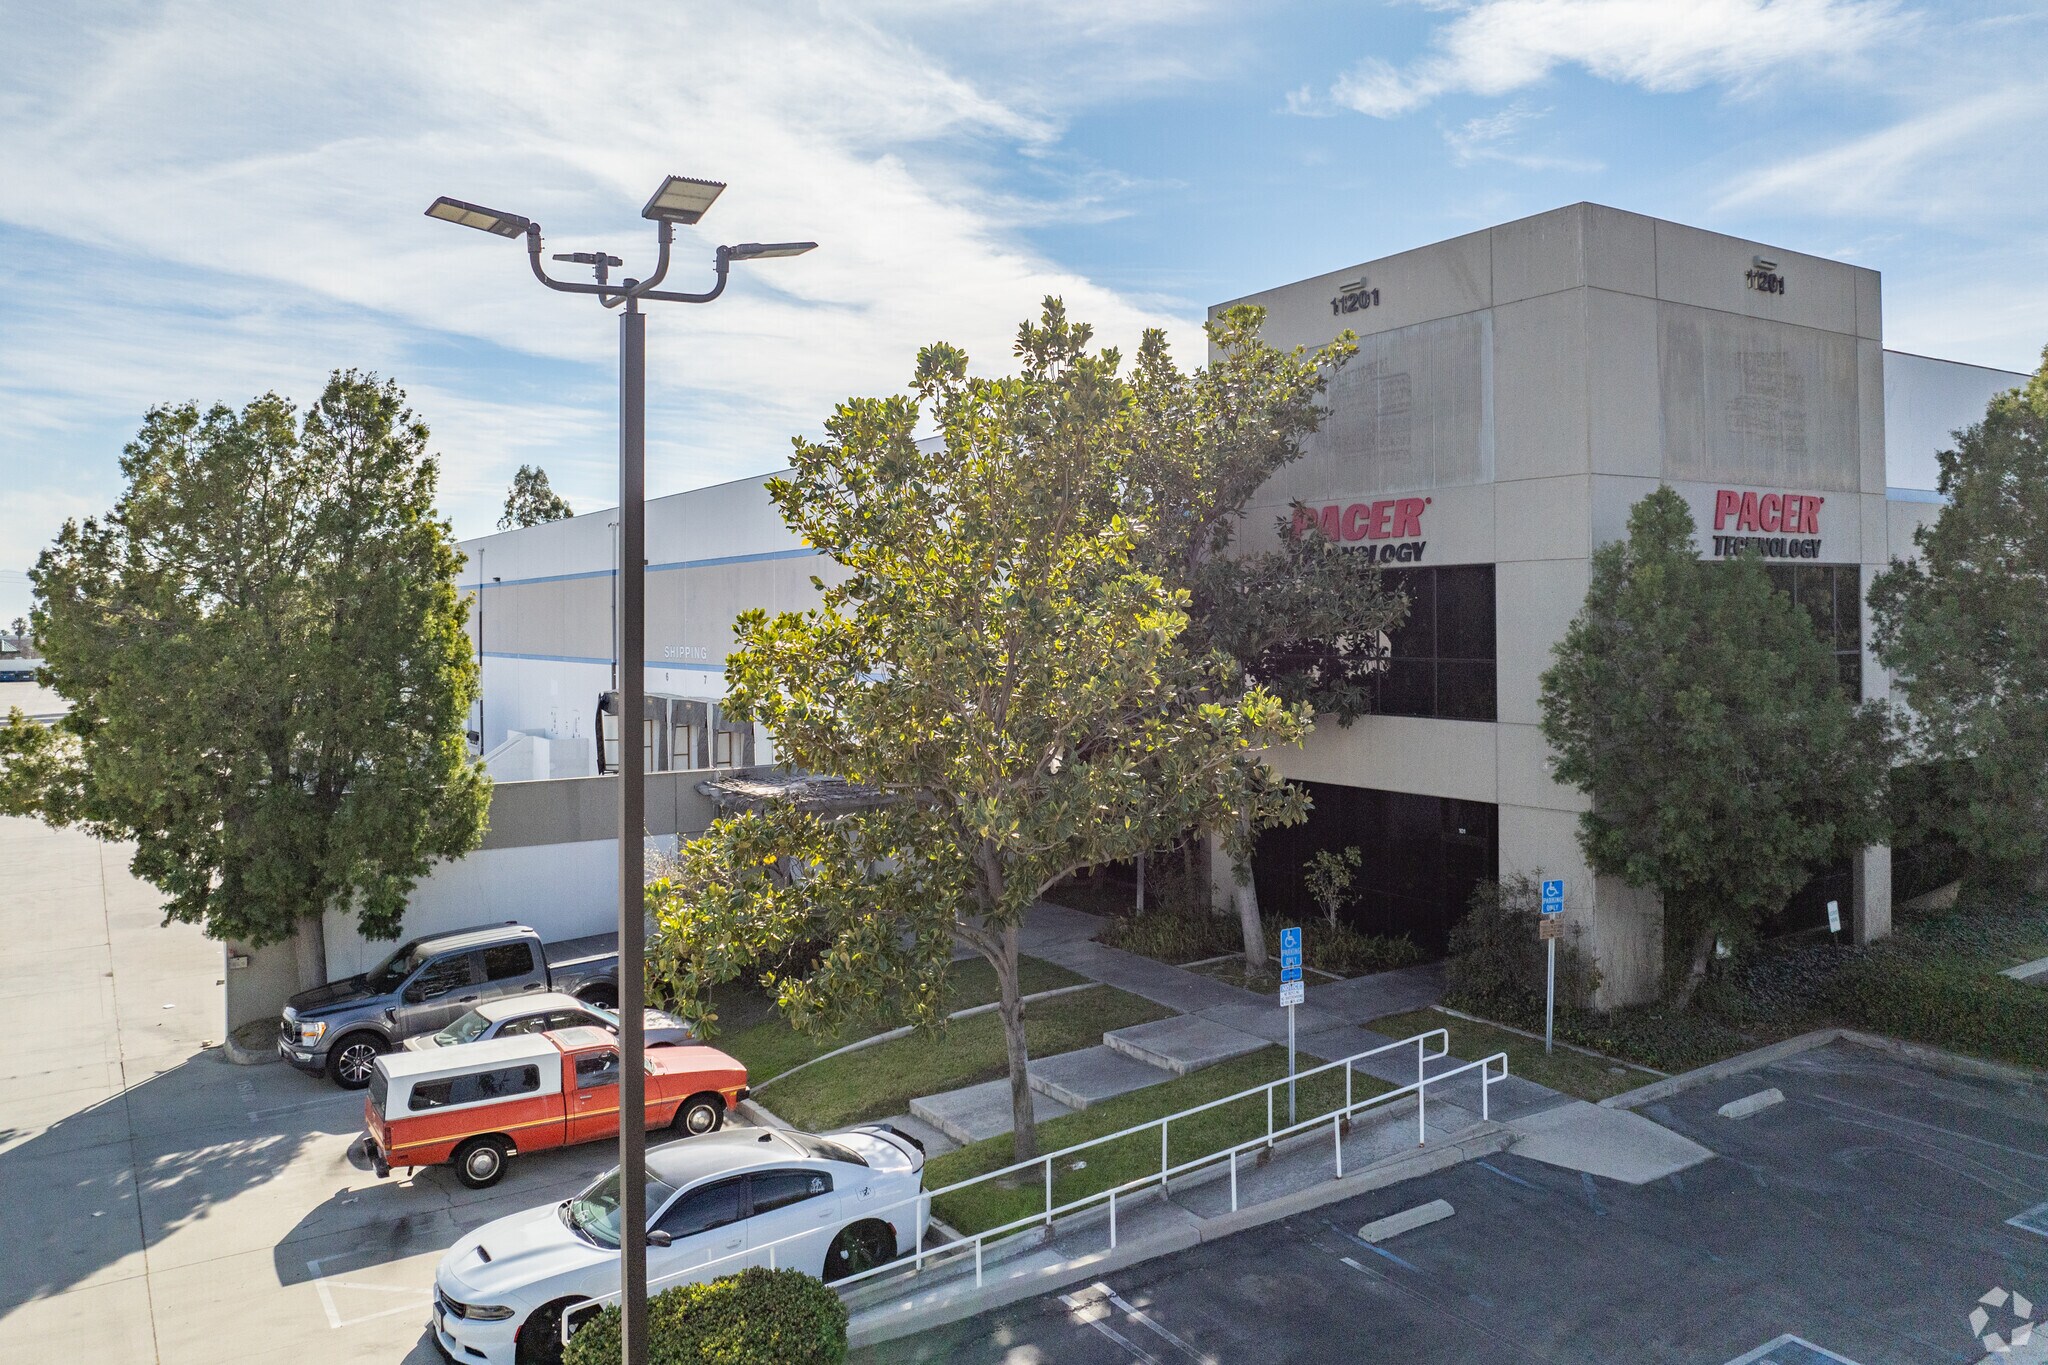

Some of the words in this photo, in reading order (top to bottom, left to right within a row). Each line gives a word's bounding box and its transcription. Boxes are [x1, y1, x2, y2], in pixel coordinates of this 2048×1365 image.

[1745, 269, 1785, 295] 11201
[1330, 288, 1380, 316] 11201
[1290, 497, 1426, 543] PACER
[1713, 489, 1822, 534] PACER
[664, 645, 707, 659] SHIPPING
[703, 674, 708, 684] 7
